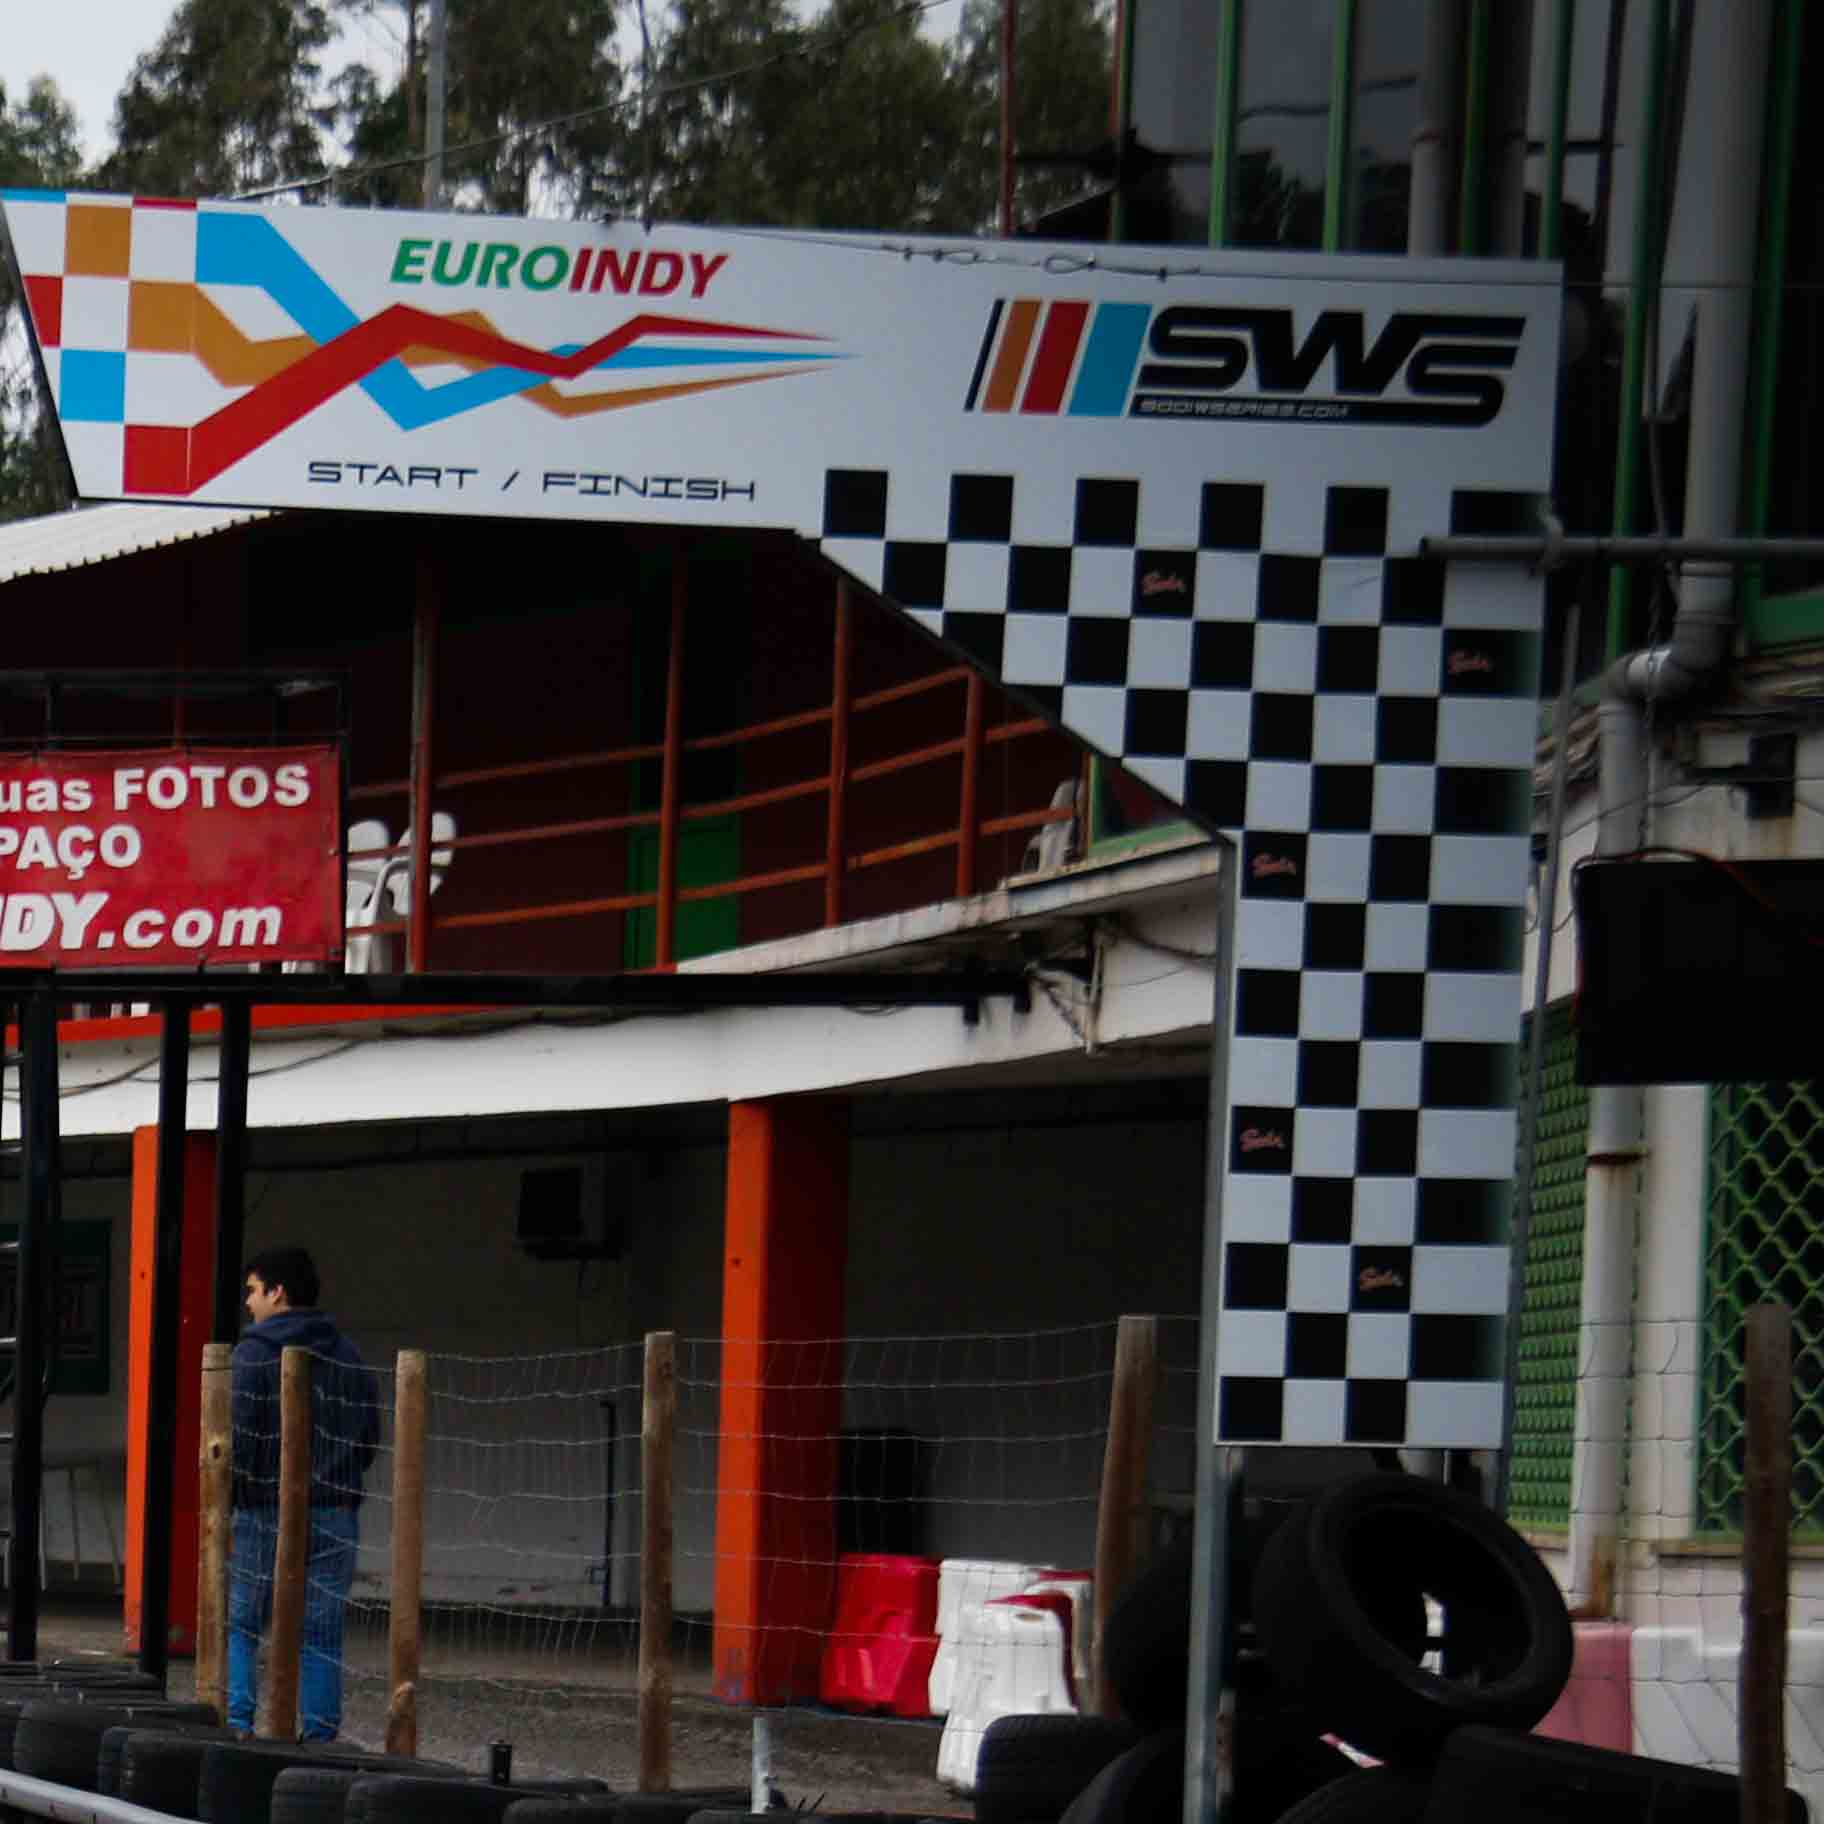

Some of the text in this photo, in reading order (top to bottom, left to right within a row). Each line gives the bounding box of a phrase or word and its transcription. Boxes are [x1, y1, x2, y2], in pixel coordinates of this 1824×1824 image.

[389, 238, 728, 297] EUROINDY
[1132, 306, 1526, 427] SWS
[307, 461, 479, 489] START
[542, 472, 755, 501] FINISH
[112, 764, 311, 811] FOTOS
